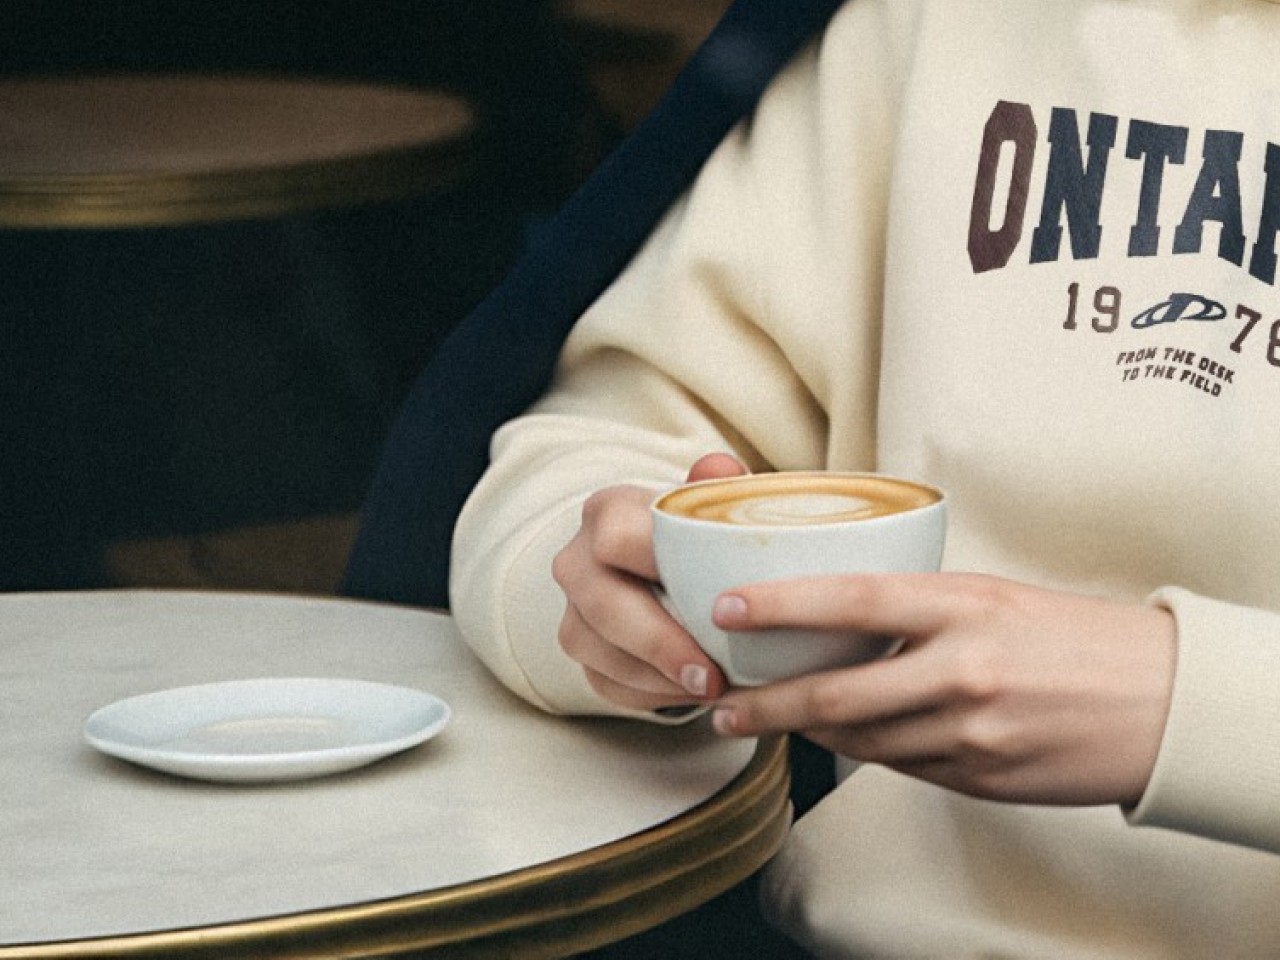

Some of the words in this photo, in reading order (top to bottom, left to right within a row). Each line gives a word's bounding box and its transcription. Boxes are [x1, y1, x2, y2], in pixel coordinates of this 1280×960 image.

[1062, 282, 1122, 333] 19
[1116, 347, 1157, 365] FROM
[1164, 347, 1196, 365] THE
[1198, 356, 1235, 384] DESK
[1122, 367, 1140, 382] TO
[1145, 365, 1177, 380] THE
[1179, 369, 1222, 397] FIELD
